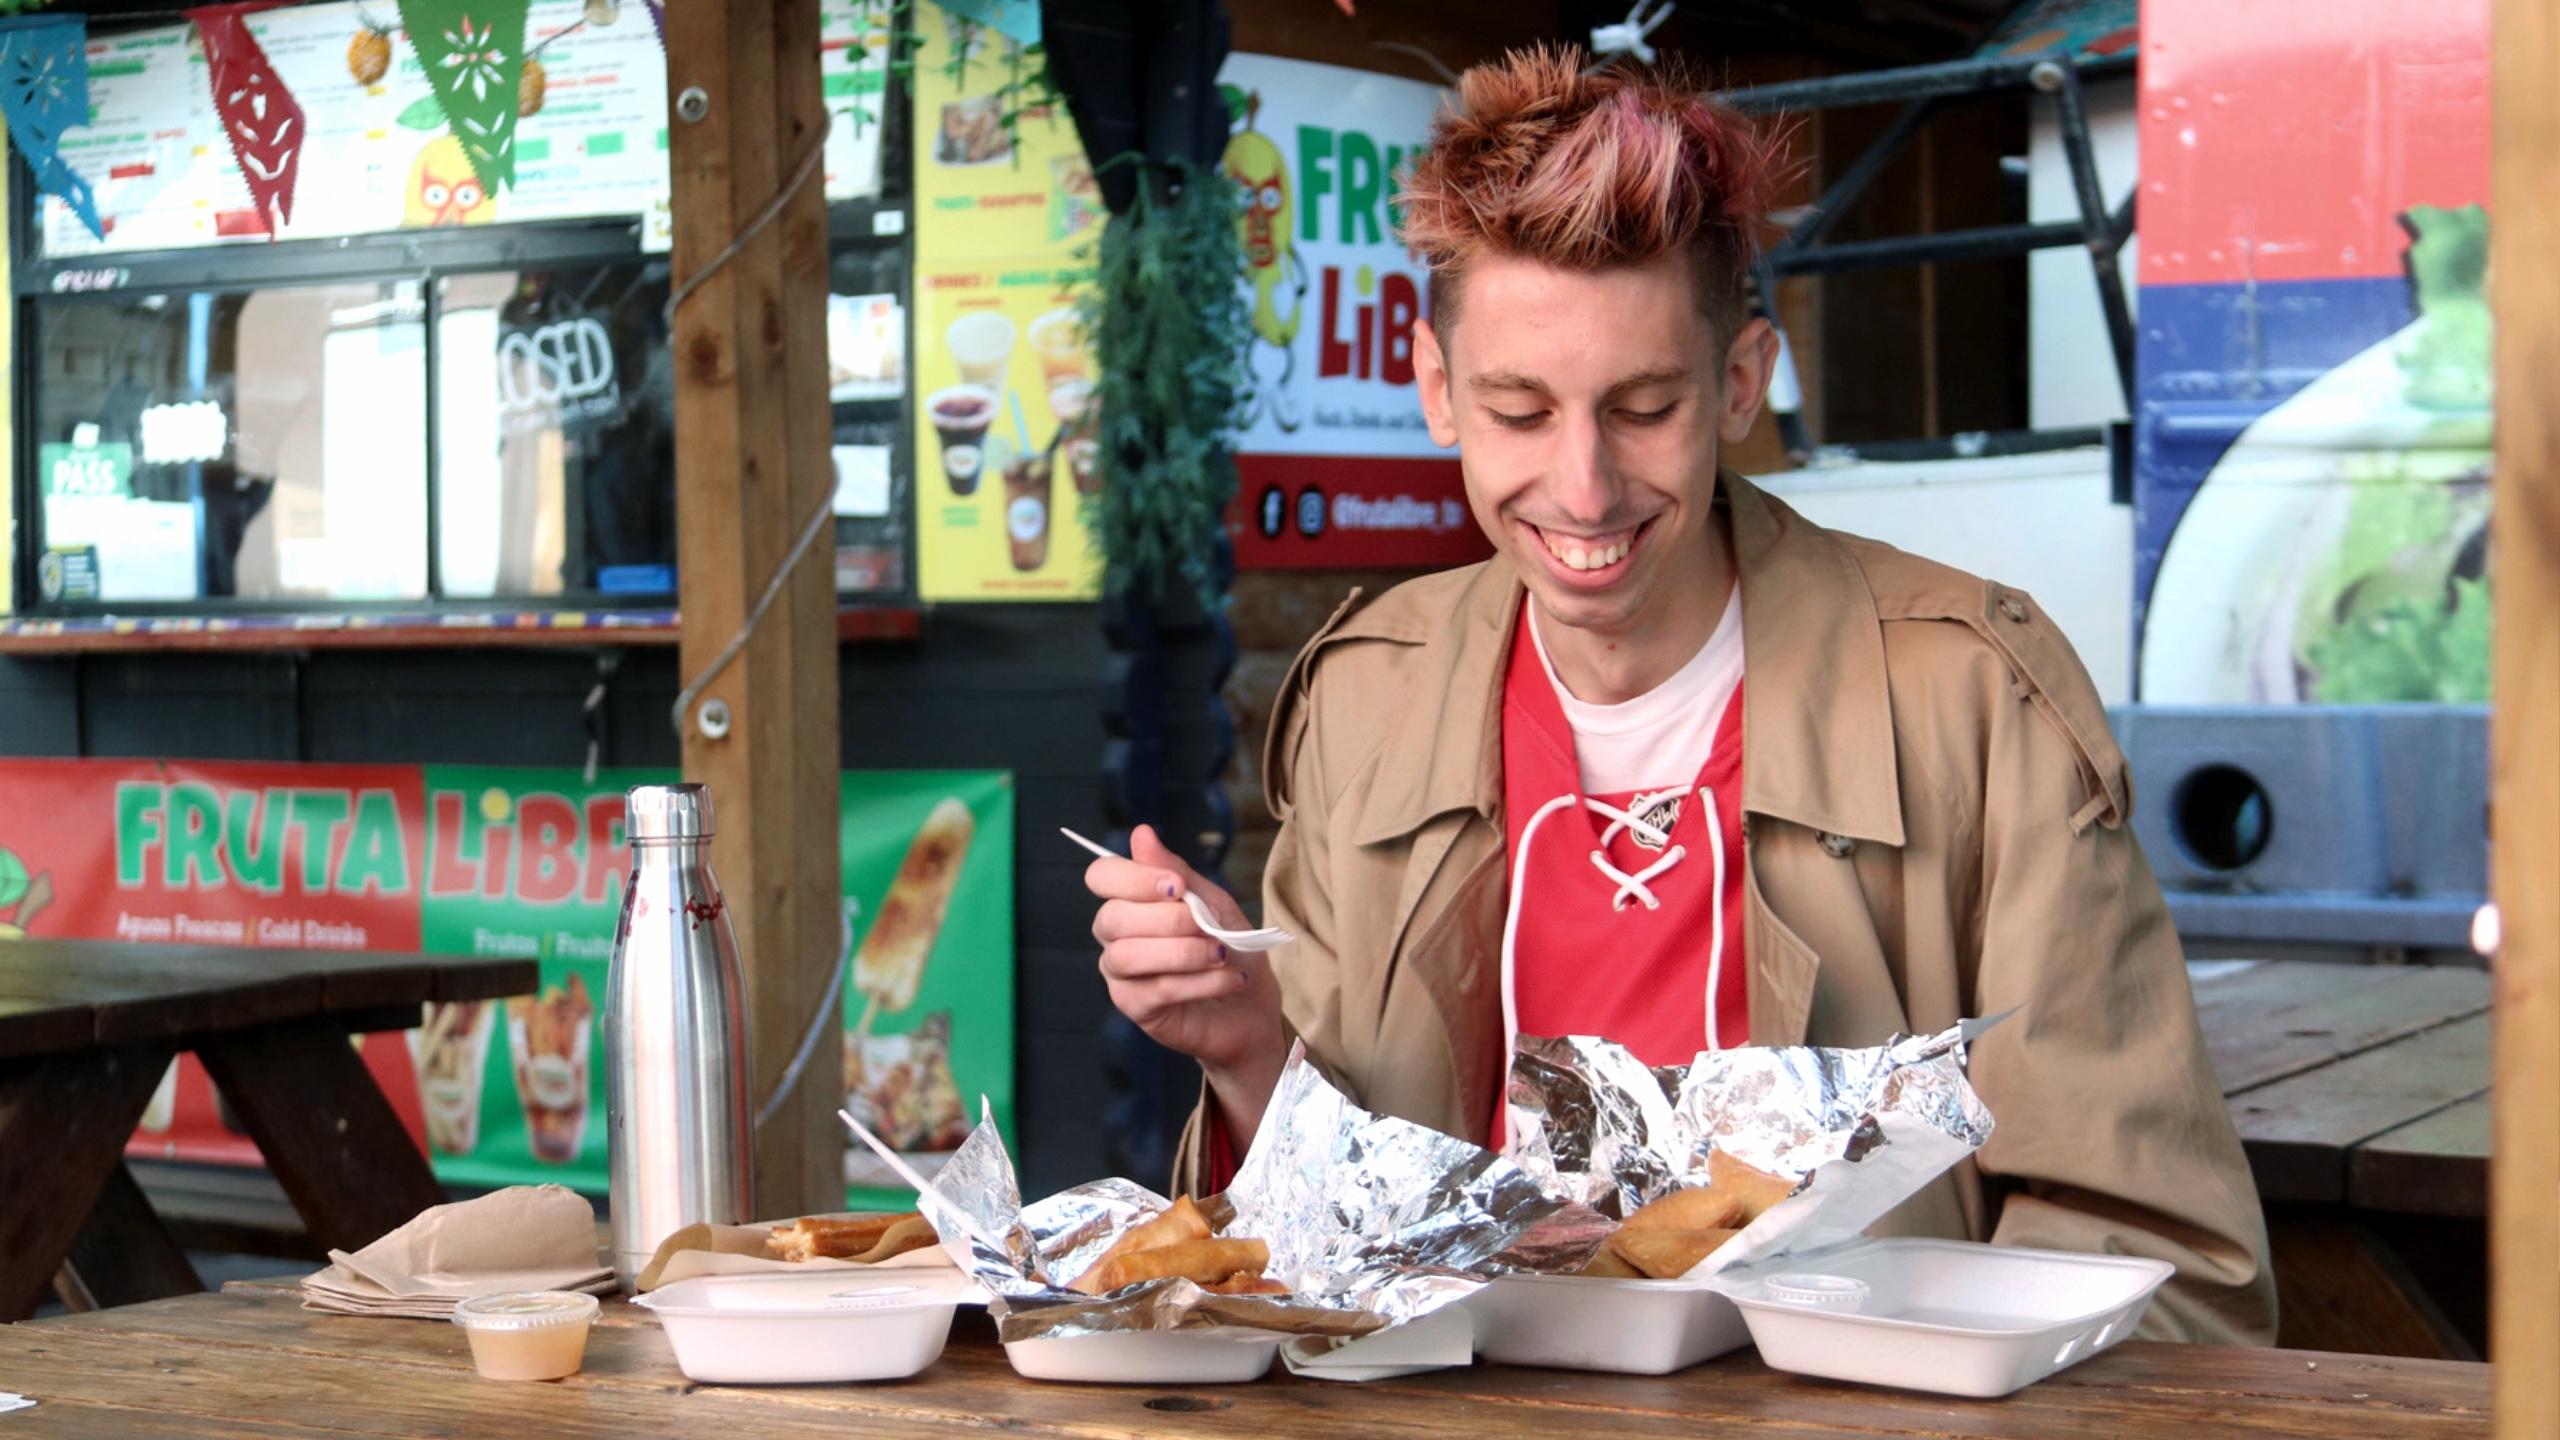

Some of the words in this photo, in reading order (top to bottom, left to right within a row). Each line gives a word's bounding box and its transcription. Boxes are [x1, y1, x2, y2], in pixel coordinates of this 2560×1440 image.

[1297, 124, 1425, 247] FRU
[1318, 265, 1420, 386] LiB
[53, 459, 117, 494] PASS
[116, 780, 410, 896] FRUTA
[429, 788, 632, 905] LiBR
[259, 917, 301, 944] Cold
[303, 919, 367, 949] Drinks
